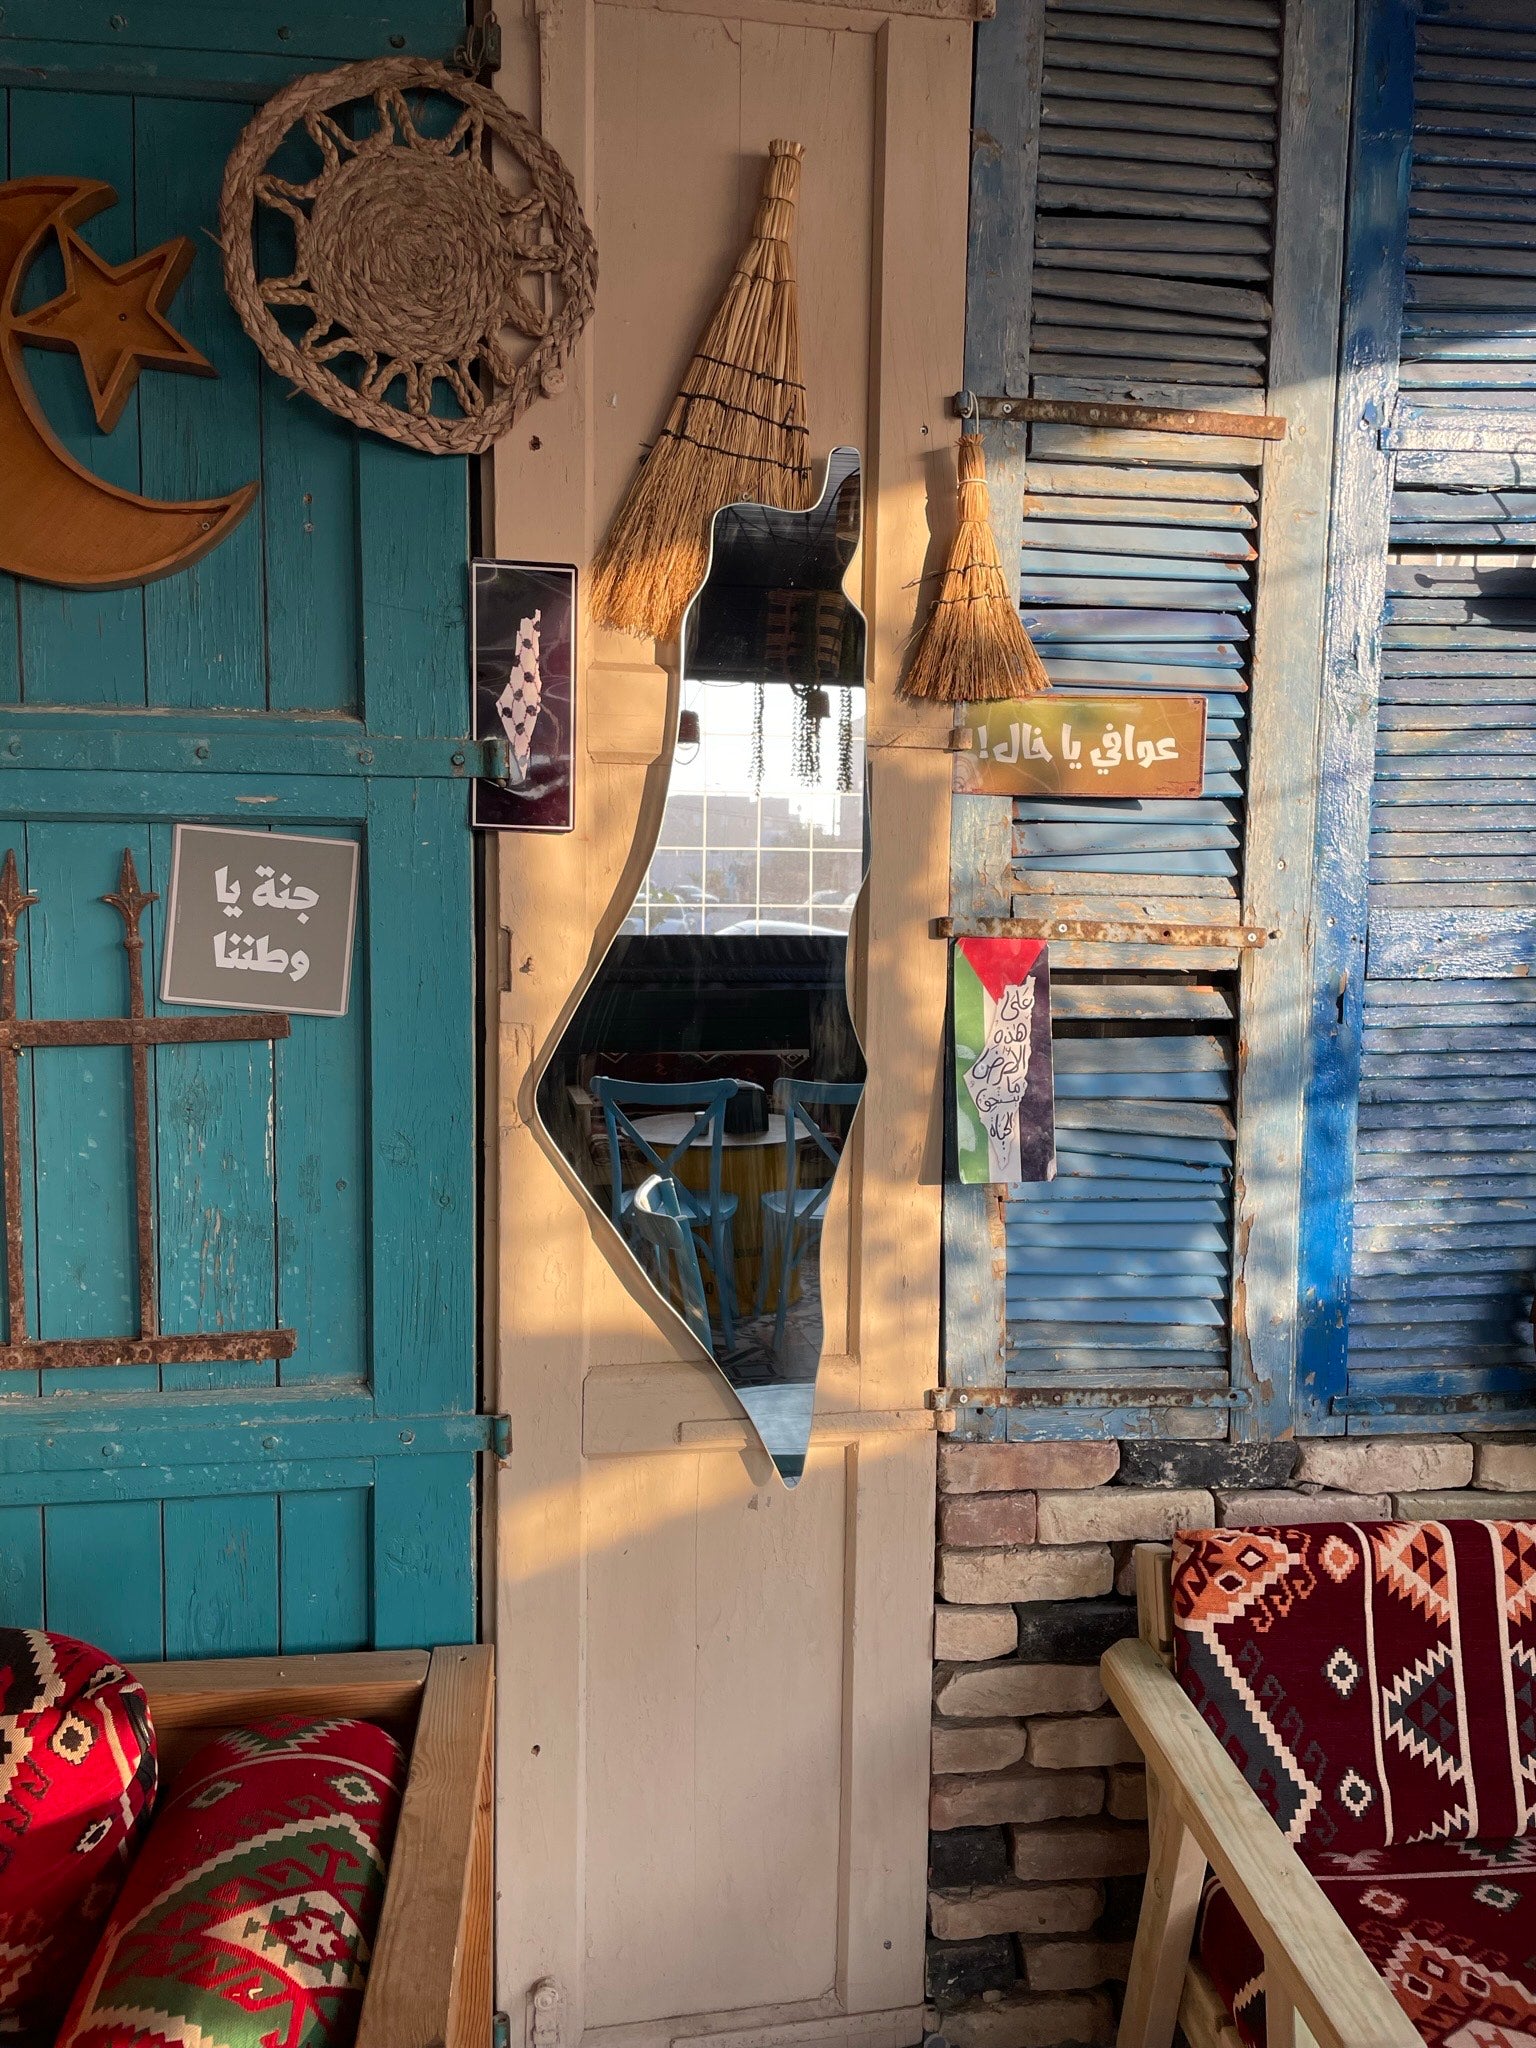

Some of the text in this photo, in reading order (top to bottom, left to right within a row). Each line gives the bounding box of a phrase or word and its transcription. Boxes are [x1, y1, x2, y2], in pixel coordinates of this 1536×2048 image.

[977, 722, 1179, 776] عوافي يا خال!
[214, 864, 320, 925] جنة يا
[213, 930, 310, 982] وطننا
